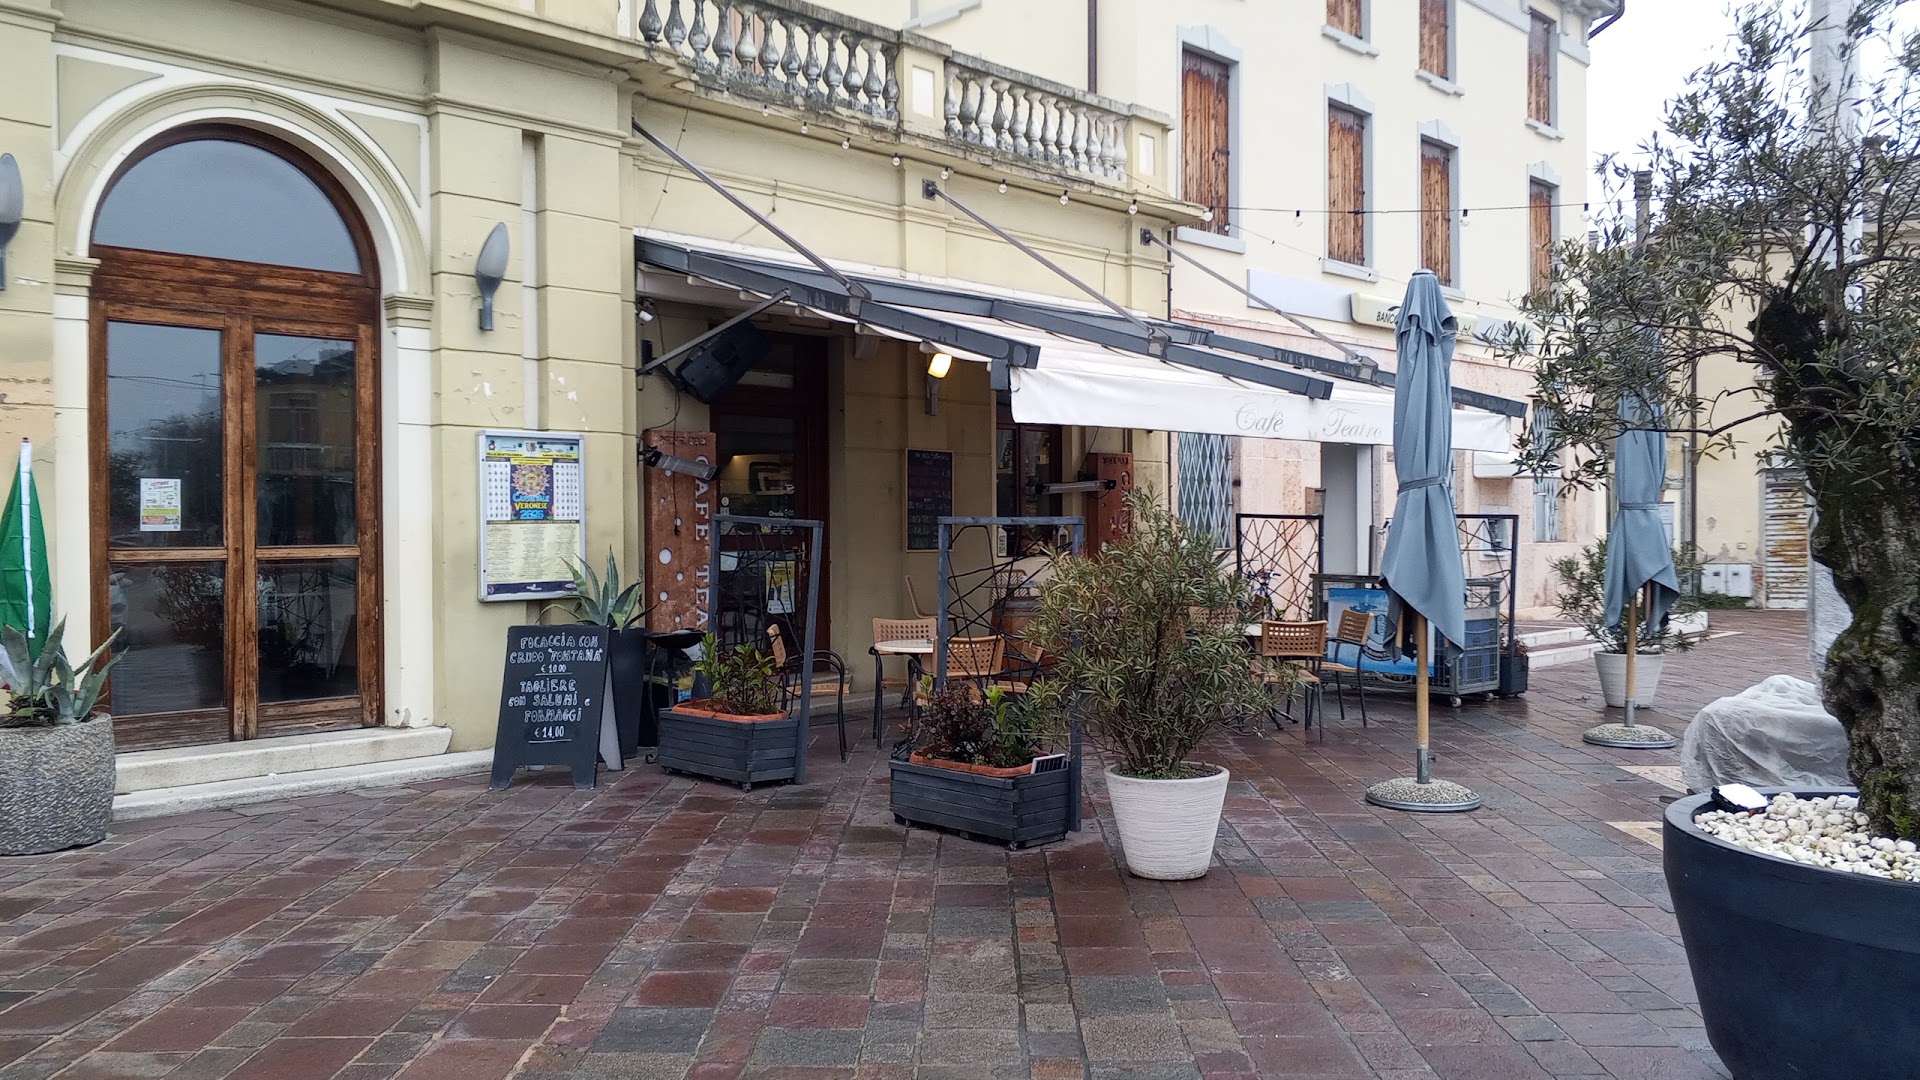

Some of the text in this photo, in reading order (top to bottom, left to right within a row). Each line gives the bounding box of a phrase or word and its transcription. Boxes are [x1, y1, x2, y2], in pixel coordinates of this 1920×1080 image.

[1322, 401, 1384, 433] Teatro
[578, 635, 599, 648] CON
[509, 651, 545, 664] CRUDO
[508, 695, 527, 707] CON
[532, 690, 578, 707] SALUMI
